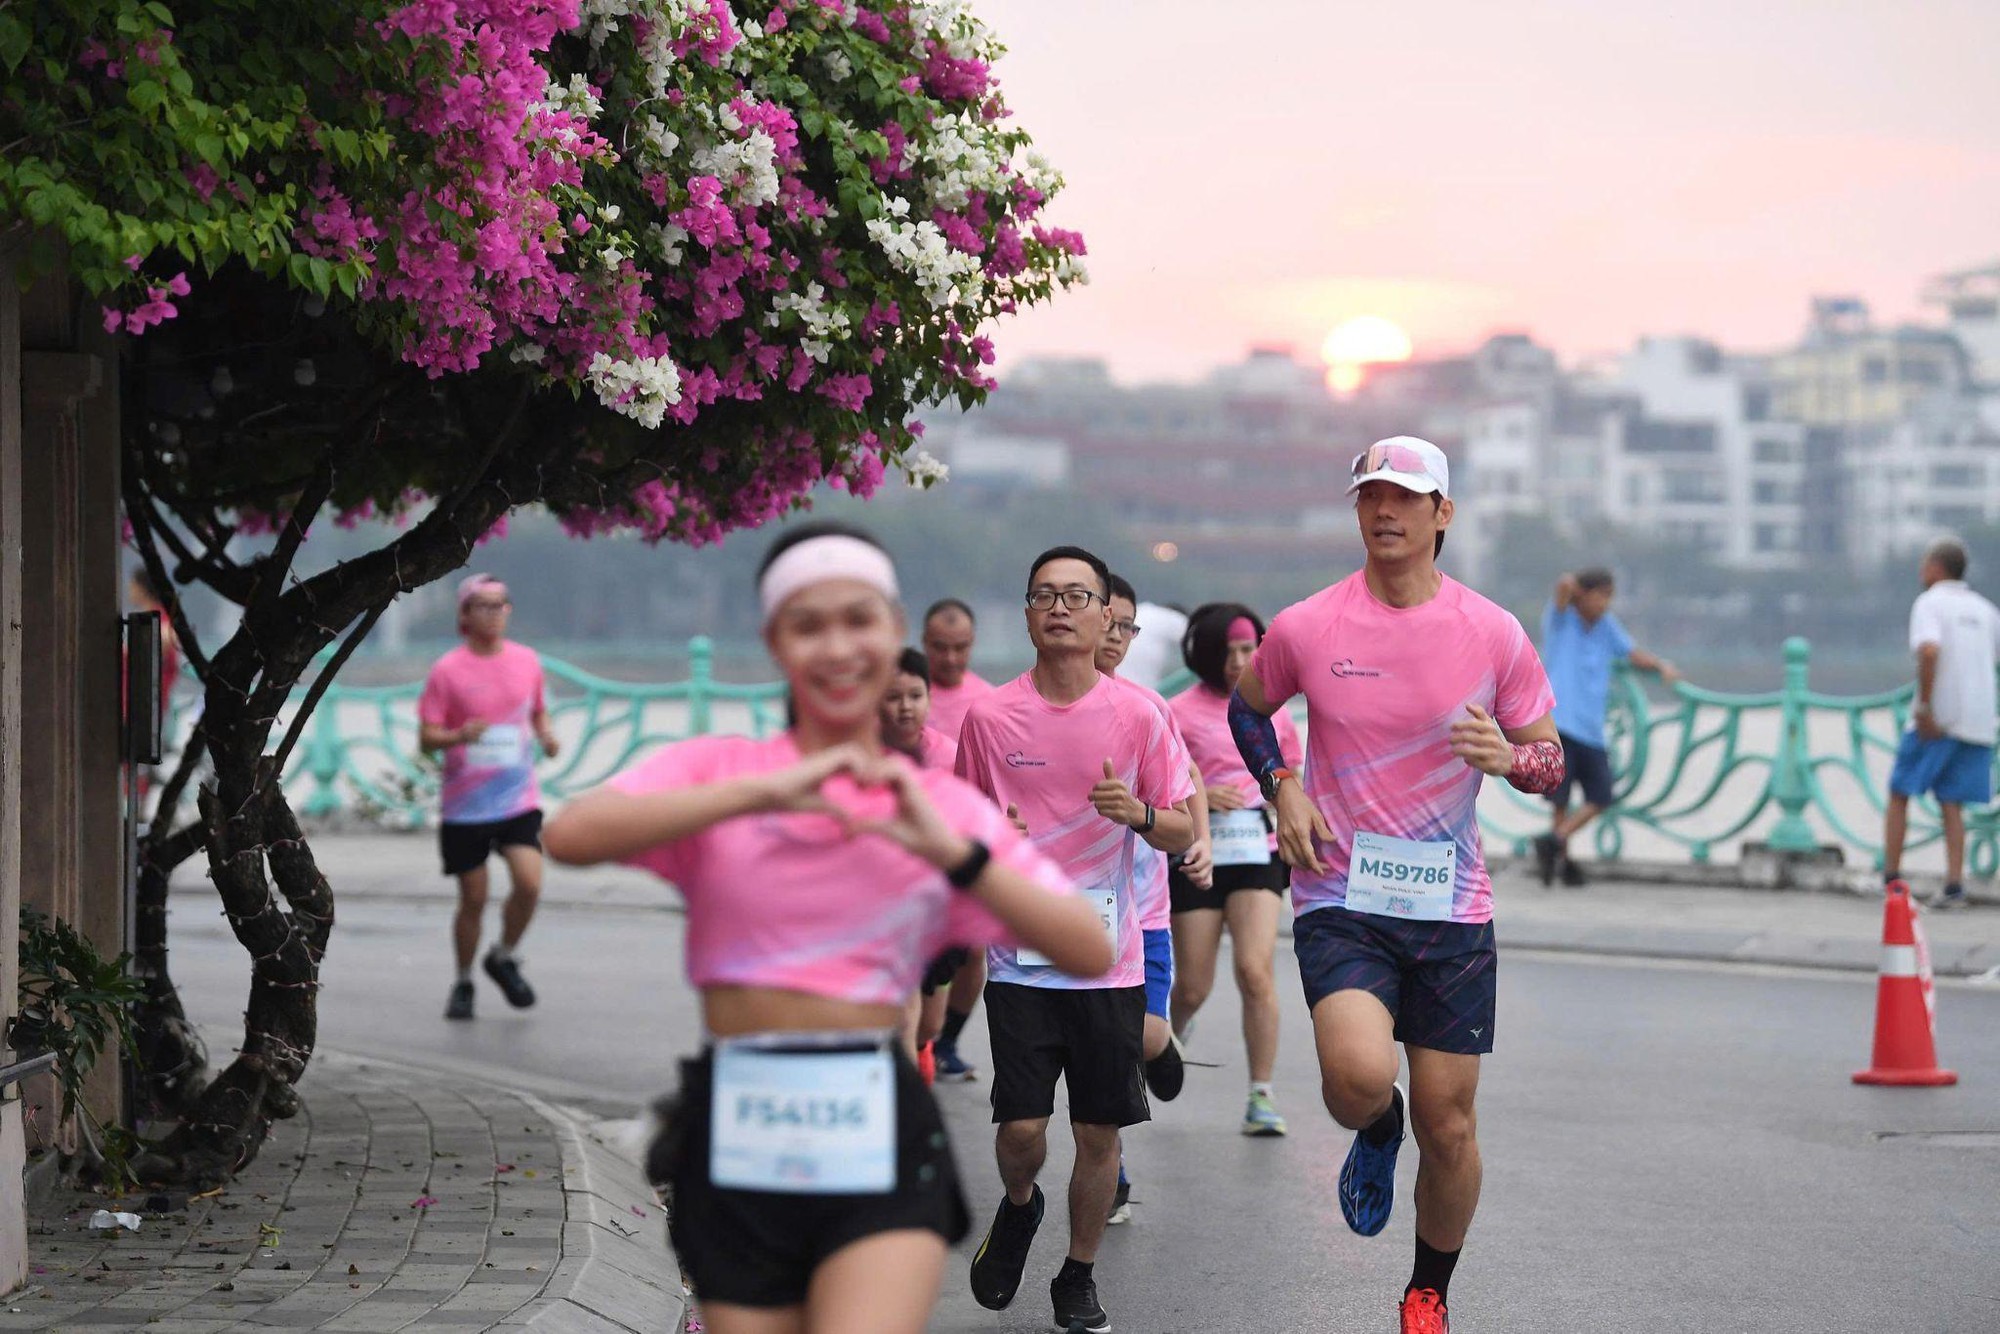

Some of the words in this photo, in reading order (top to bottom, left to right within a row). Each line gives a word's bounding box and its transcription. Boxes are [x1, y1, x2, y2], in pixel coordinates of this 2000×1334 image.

[1447, 849, 1453, 858] P
[1360, 857, 1449, 884] M59786
[1106, 897, 1113, 905] P
[736, 1098, 866, 1128] F54136
